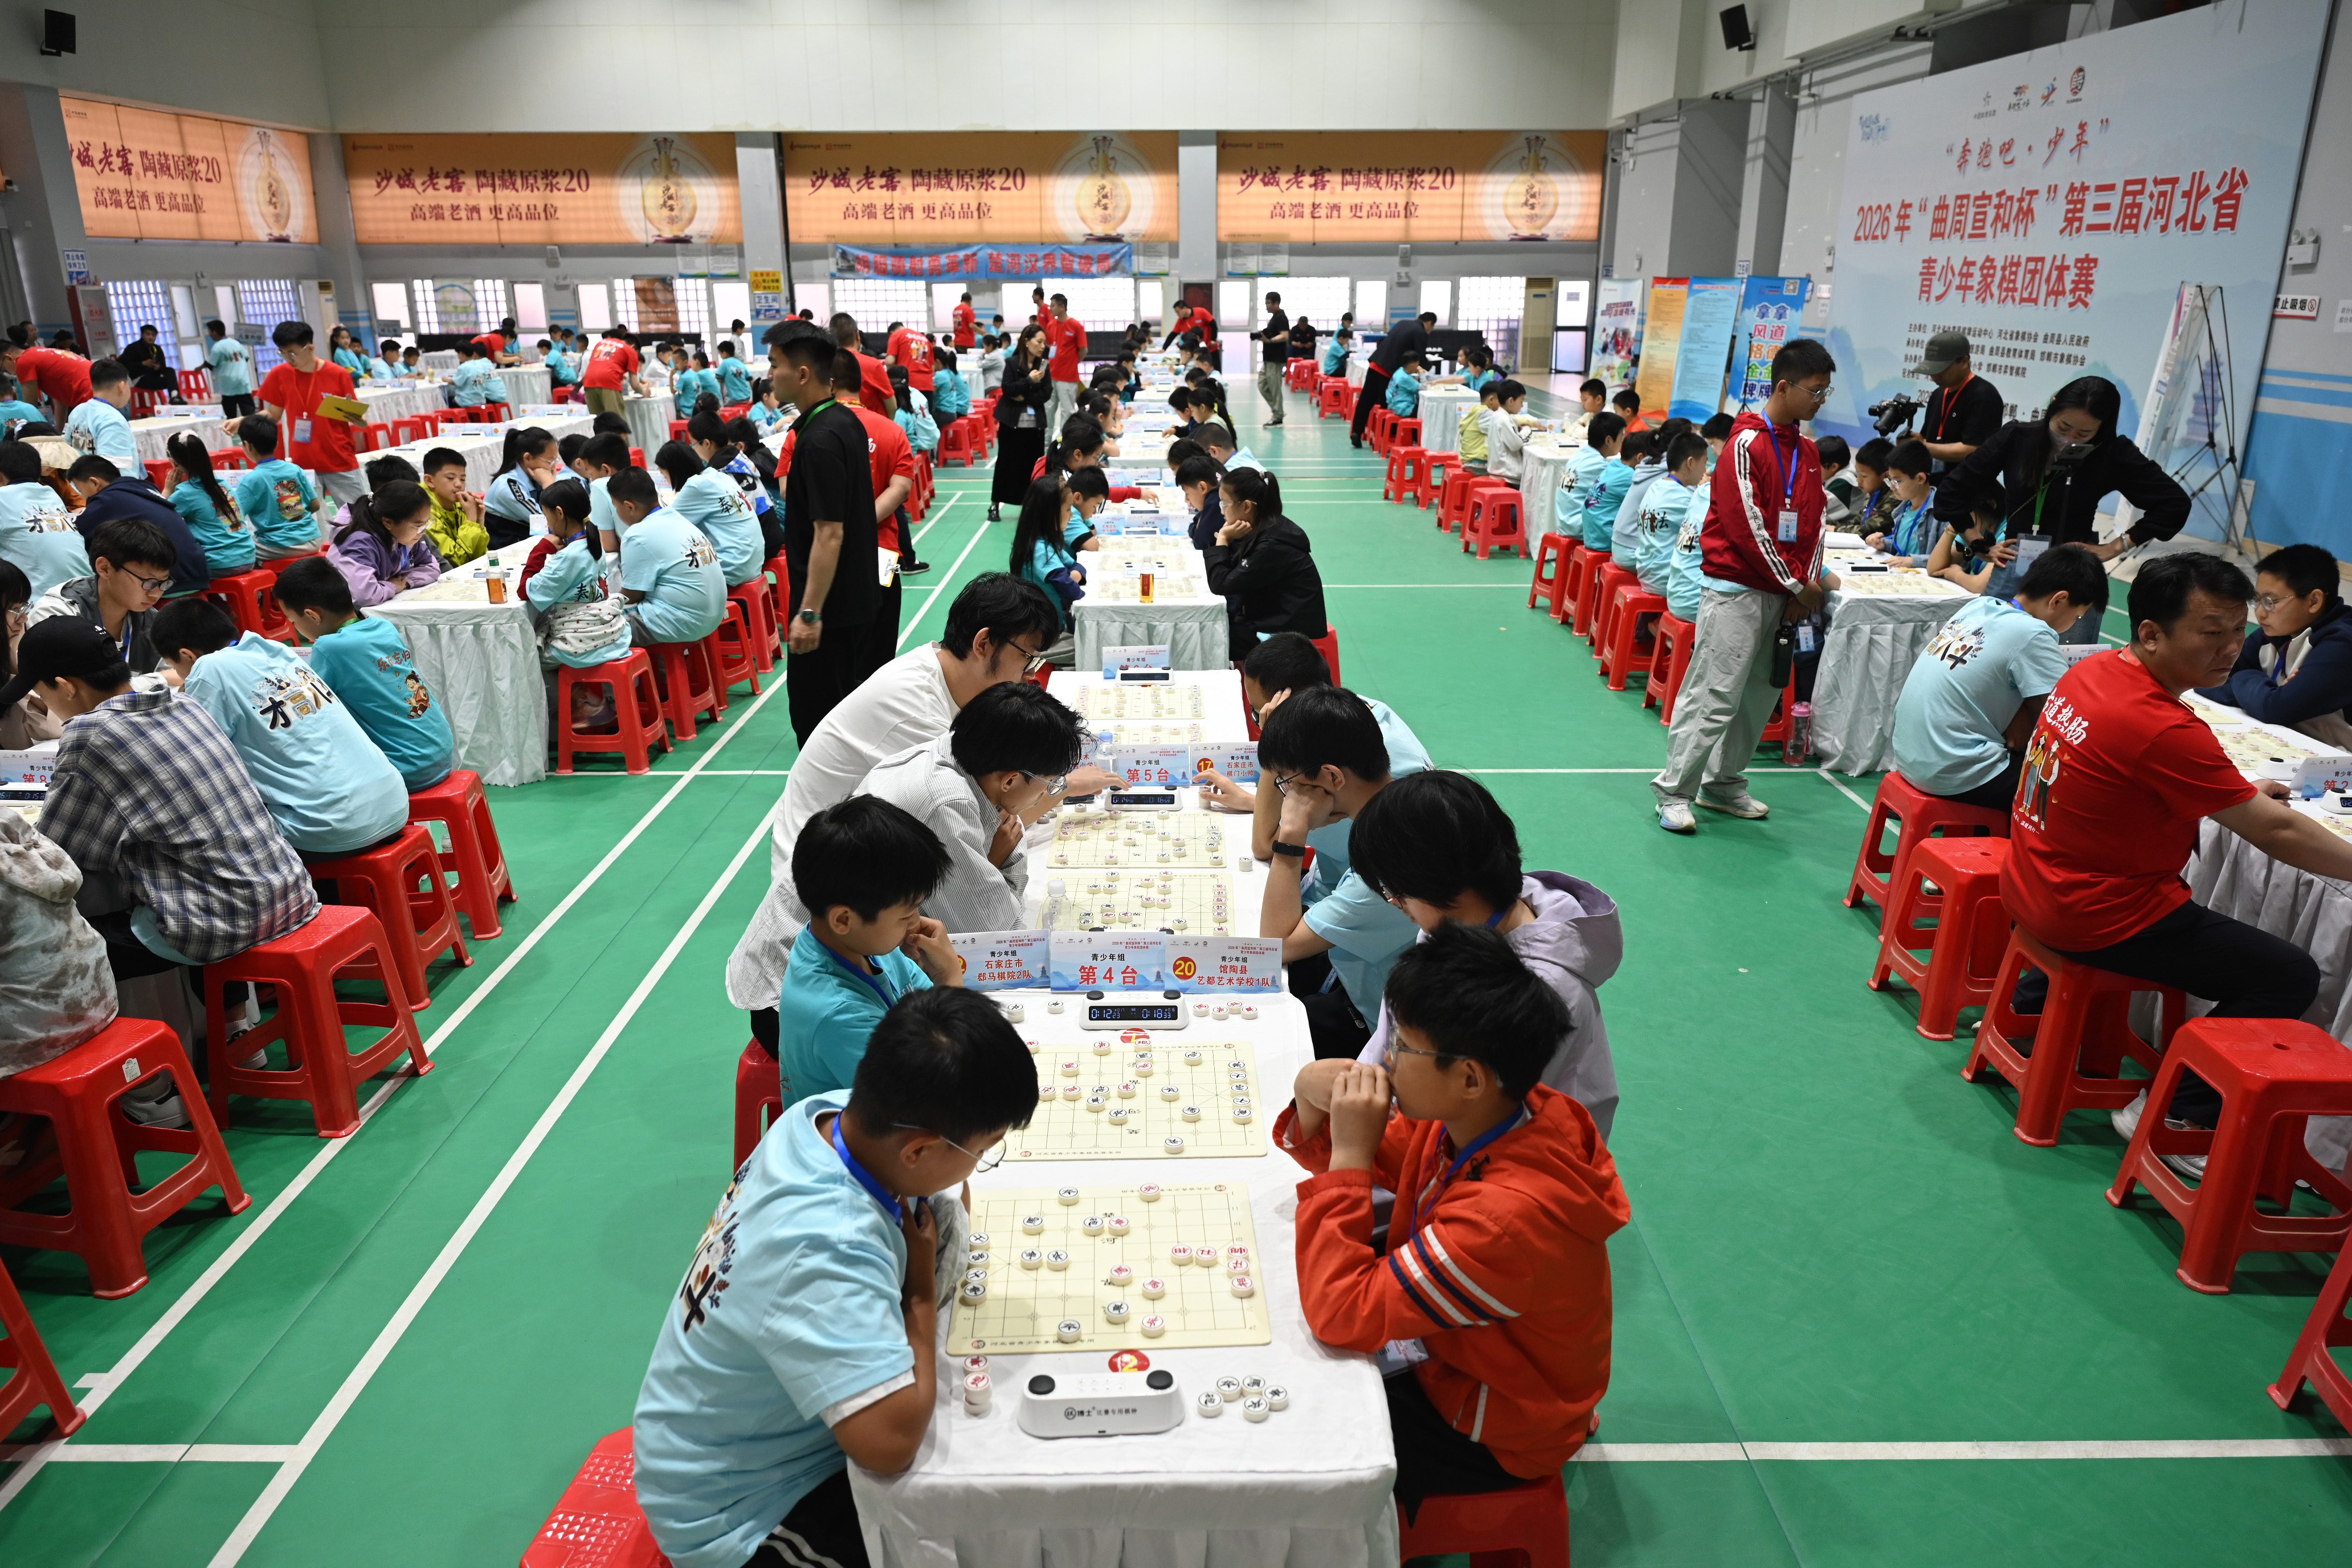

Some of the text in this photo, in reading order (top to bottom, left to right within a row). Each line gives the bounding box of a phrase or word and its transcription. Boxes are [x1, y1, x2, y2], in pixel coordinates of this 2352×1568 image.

[69, 140, 222, 183] 城老窖 陶藏原浆20
[374, 168, 590, 196] 沙城老窖 陶藏原浆20
[808, 166, 1026, 195] 沙城老窖 陶藏原浆20
[1238, 166, 1455, 194] 沙城老窖 陶藏原浆20
[93, 186, 206, 214] 高端老酒 更高品位
[410, 203, 560, 222] 高端老酒 更高品位
[843, 202, 993, 220] 高端老酒 更高品位
[1271, 201, 1419, 220] 高端老酒 更高品位
[988, 252, 1112, 275] 楚河汉界智破局
[1918, 252, 2098, 309] 青少年象棋团体赛
[1126, 767, 1170, 783] 第5台
[1199, 761, 1212, 771] 17
[985, 958, 1023, 969] 石家庄市
[1091, 953, 1125, 962] 青少年组
[1078, 964, 1139, 986] 第4台
[1174, 959, 1195, 976] 20
[1219, 963, 1248, 975] 馆陶县
[1197, 975, 1271, 987] 艺都艺术学校1队
[1091, 1008, 1112, 1019] 0:12
[1142, 1008, 1162, 1019] 0:18
